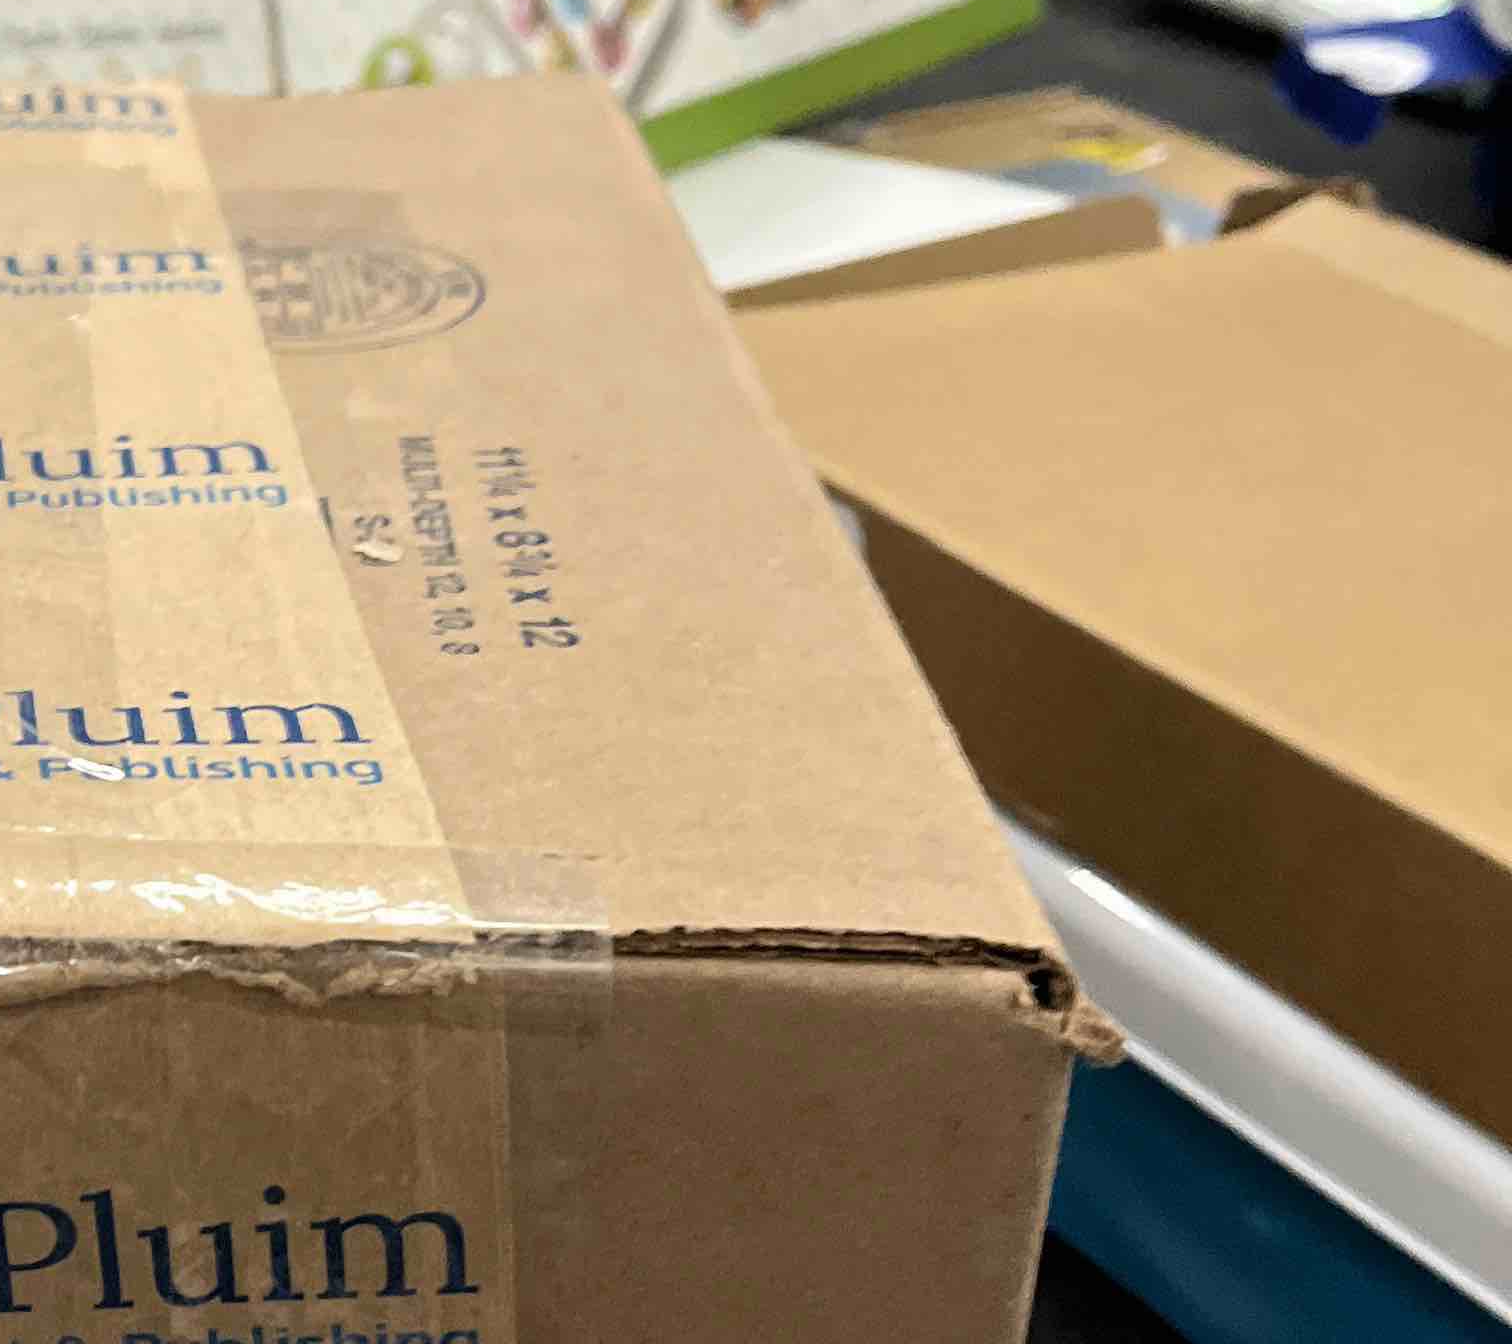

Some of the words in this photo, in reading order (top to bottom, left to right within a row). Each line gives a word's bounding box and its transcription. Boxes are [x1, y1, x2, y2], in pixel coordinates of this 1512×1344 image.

[6, 479, 290, 512] Publishing
[440, 641, 481, 657] 8
[519, 616, 581, 651] 12
